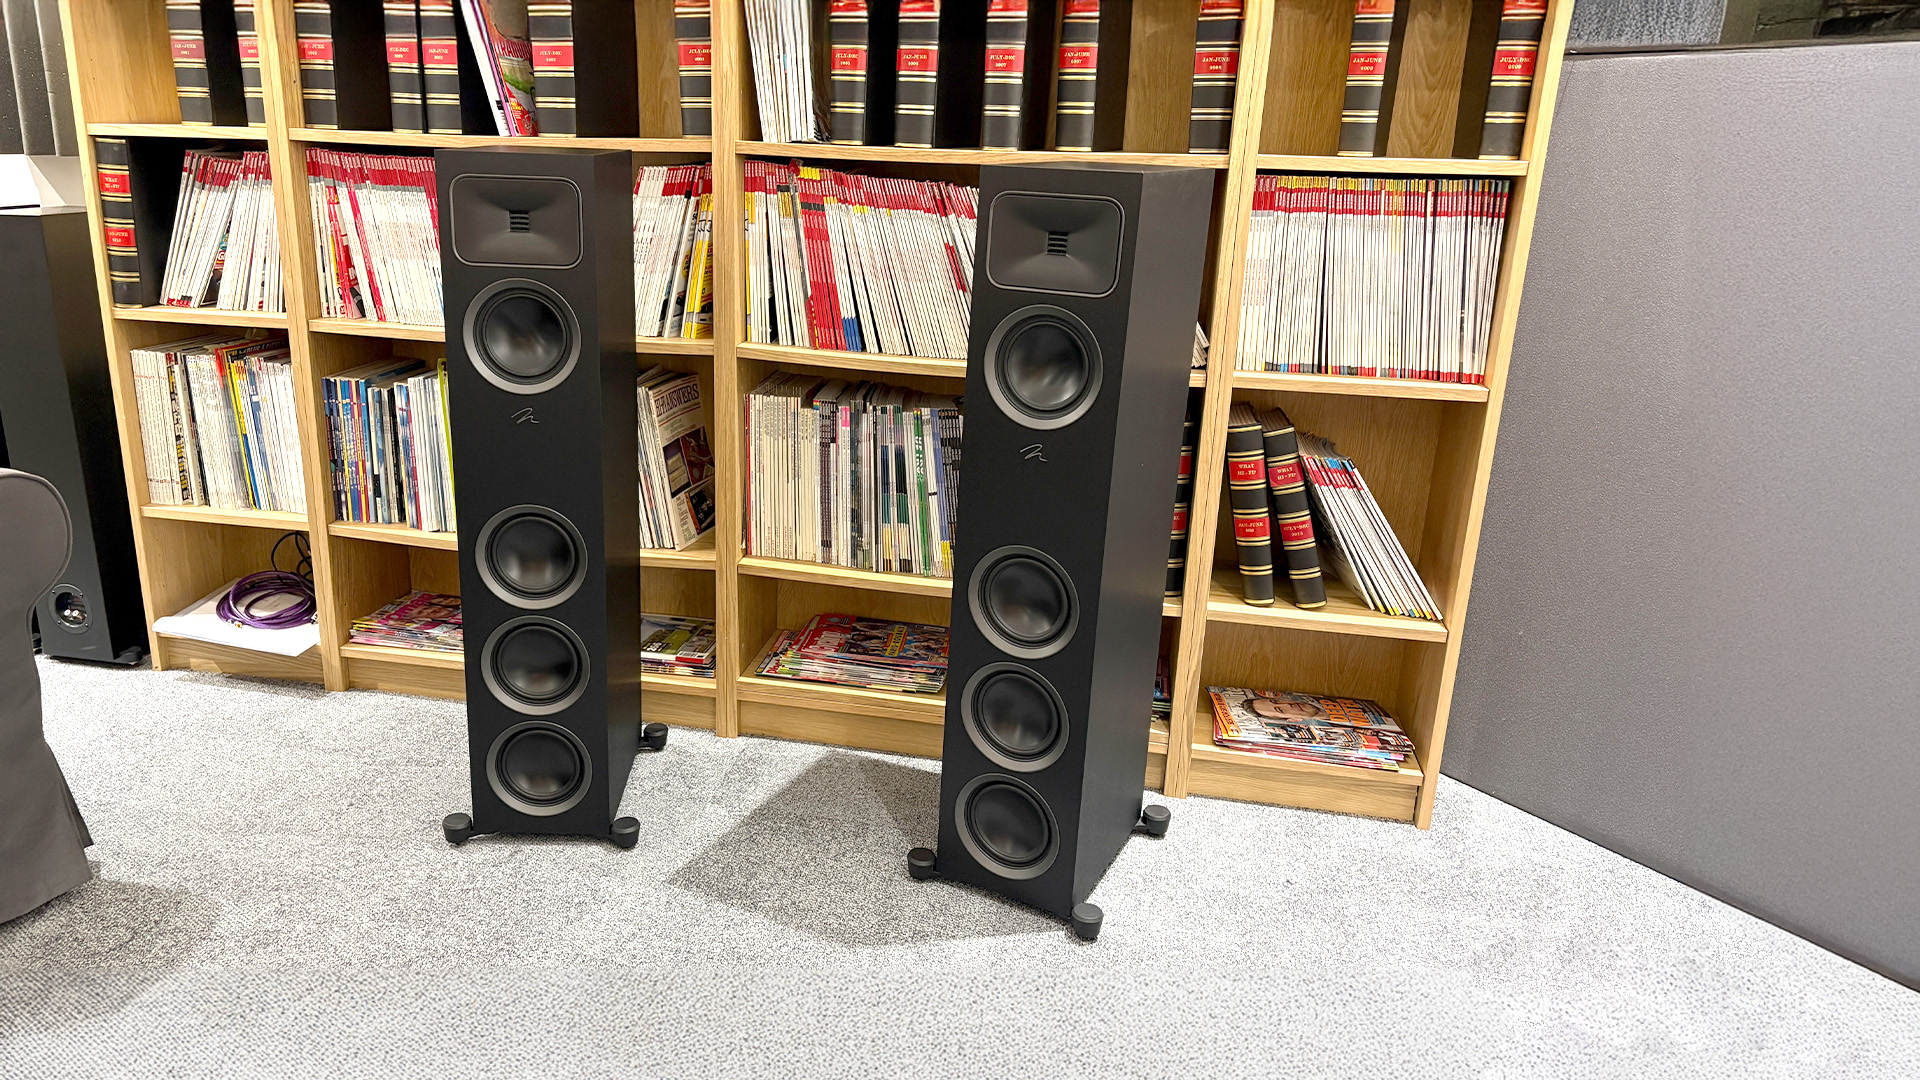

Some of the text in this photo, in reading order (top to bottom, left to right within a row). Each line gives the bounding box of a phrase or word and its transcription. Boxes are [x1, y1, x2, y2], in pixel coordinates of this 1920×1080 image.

[665, 383, 700, 412] ANSWERS
[1320, 699, 1350, 722] DEEP
[1336, 699, 1372, 726] WATER
